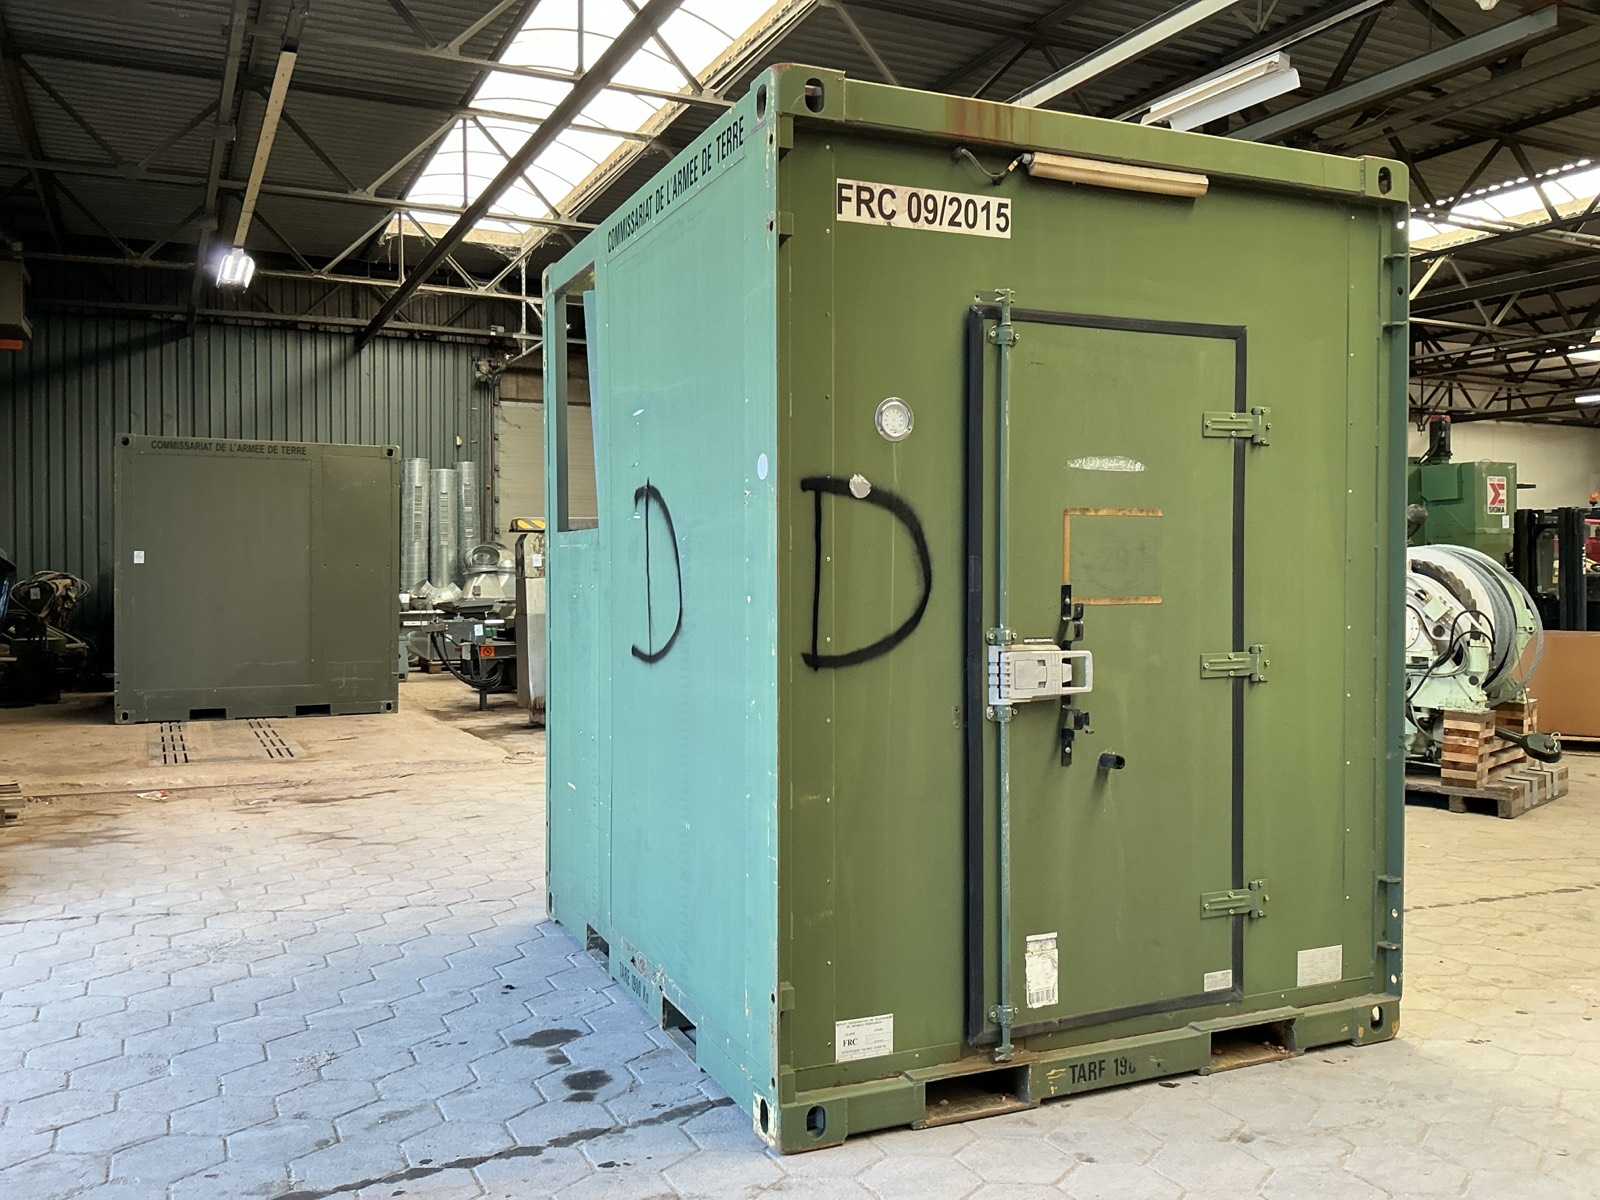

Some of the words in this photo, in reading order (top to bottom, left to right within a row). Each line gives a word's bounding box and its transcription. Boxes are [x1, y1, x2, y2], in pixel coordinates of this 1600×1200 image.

[607, 195, 653, 253] COMMISSARIAT
[655, 185, 665, 215] DE
[666, 155, 699, 205] L'ARMEE
[701, 143, 712, 177] DE
[716, 115, 744, 164] TERRE
[837, 183, 897, 221] FRC
[907, 192, 1010, 233] 09/2015
[151, 440, 212, 450] COMMISSARIAT
[215, 443, 226, 452] DE
[229, 443, 265, 454] L'ARMEE
[267, 446, 279, 454] DE
[281, 446, 307, 456] TERRE
[631, 477, 682, 664] D
[801, 476, 932, 670] D
[842, 1038, 858, 1048] FRC
